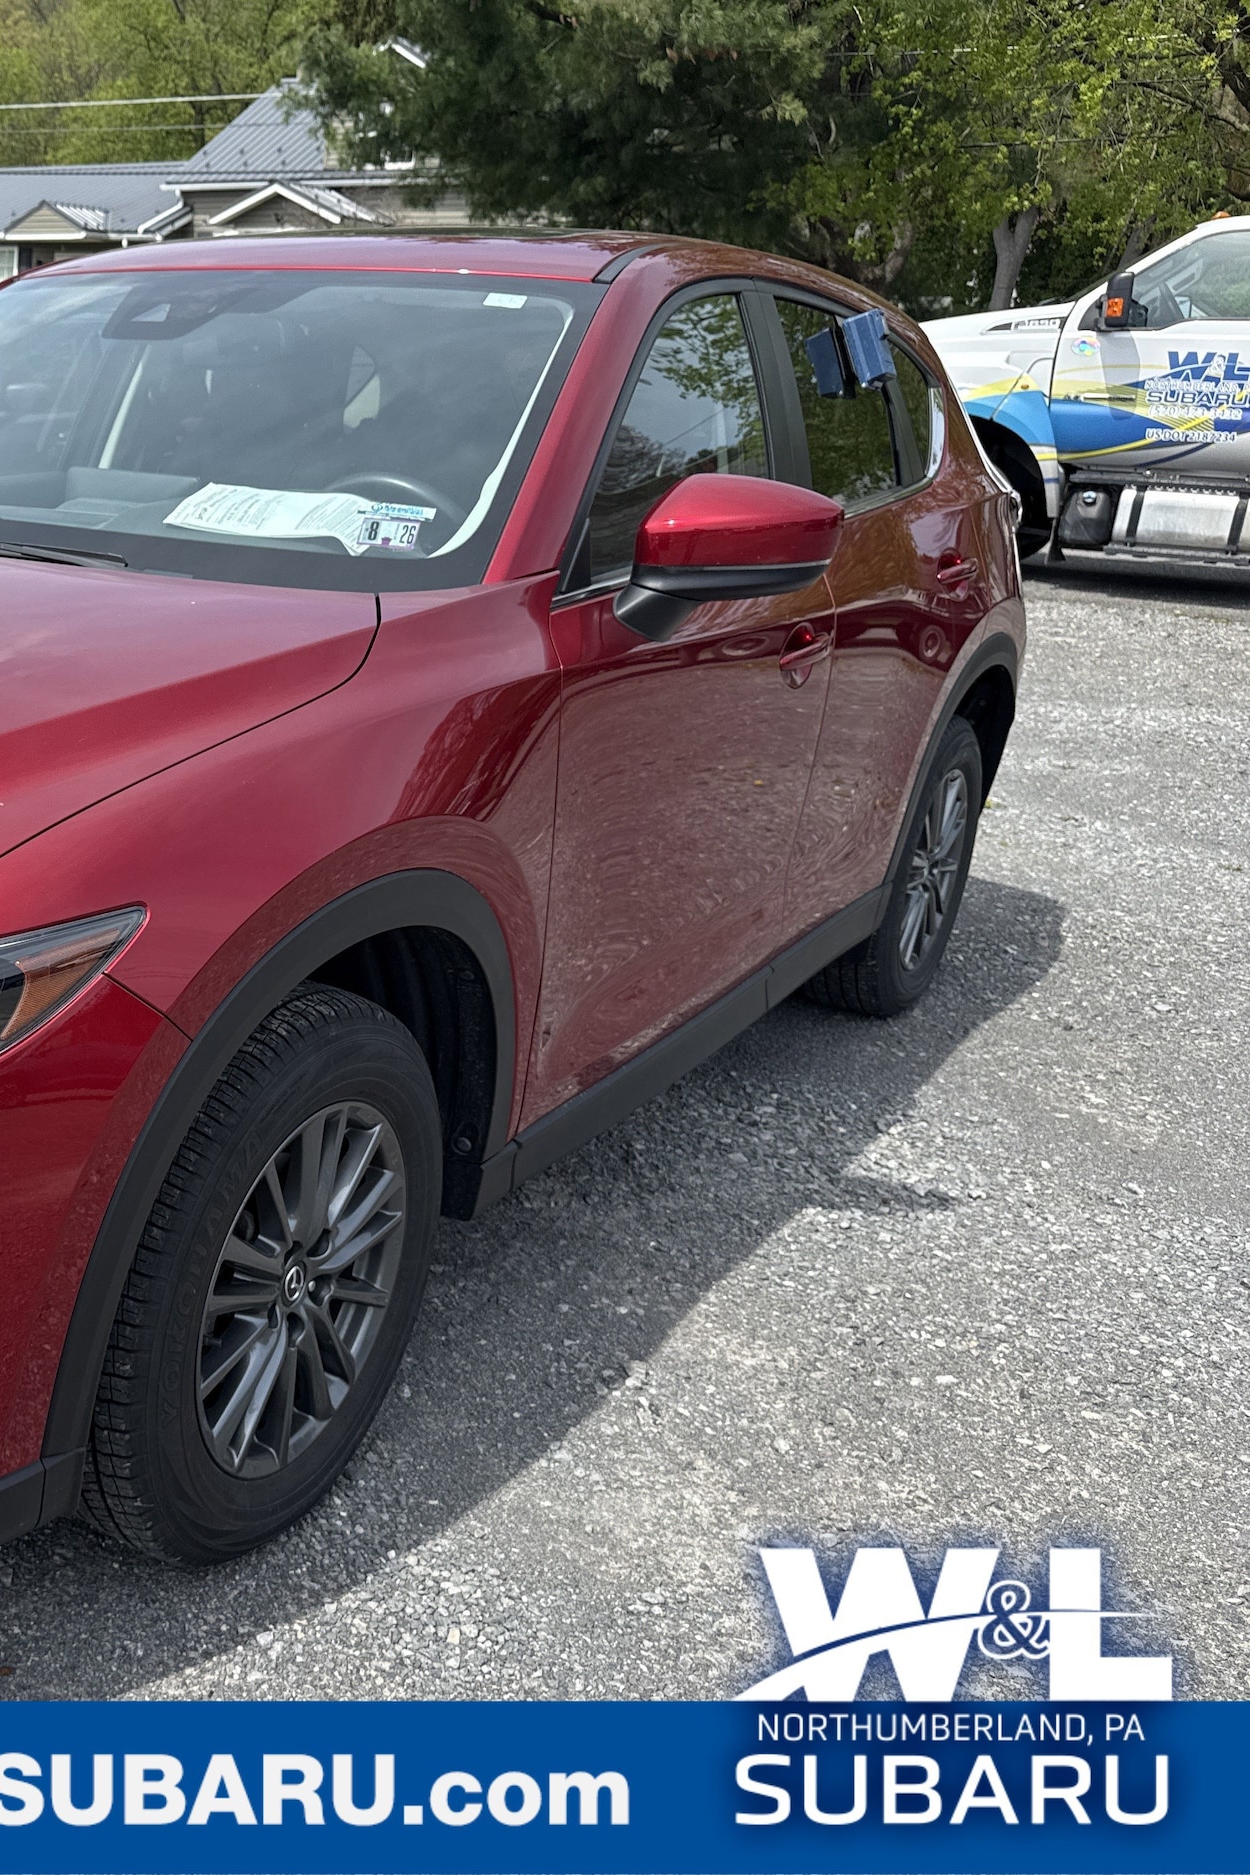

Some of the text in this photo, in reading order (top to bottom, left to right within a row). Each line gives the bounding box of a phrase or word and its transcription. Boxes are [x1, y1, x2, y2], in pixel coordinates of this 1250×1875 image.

[1168, 351, 1250, 381] W&L
[1146, 391, 1248, 407] SUBARU
[367, 521, 417, 544] 8 26
